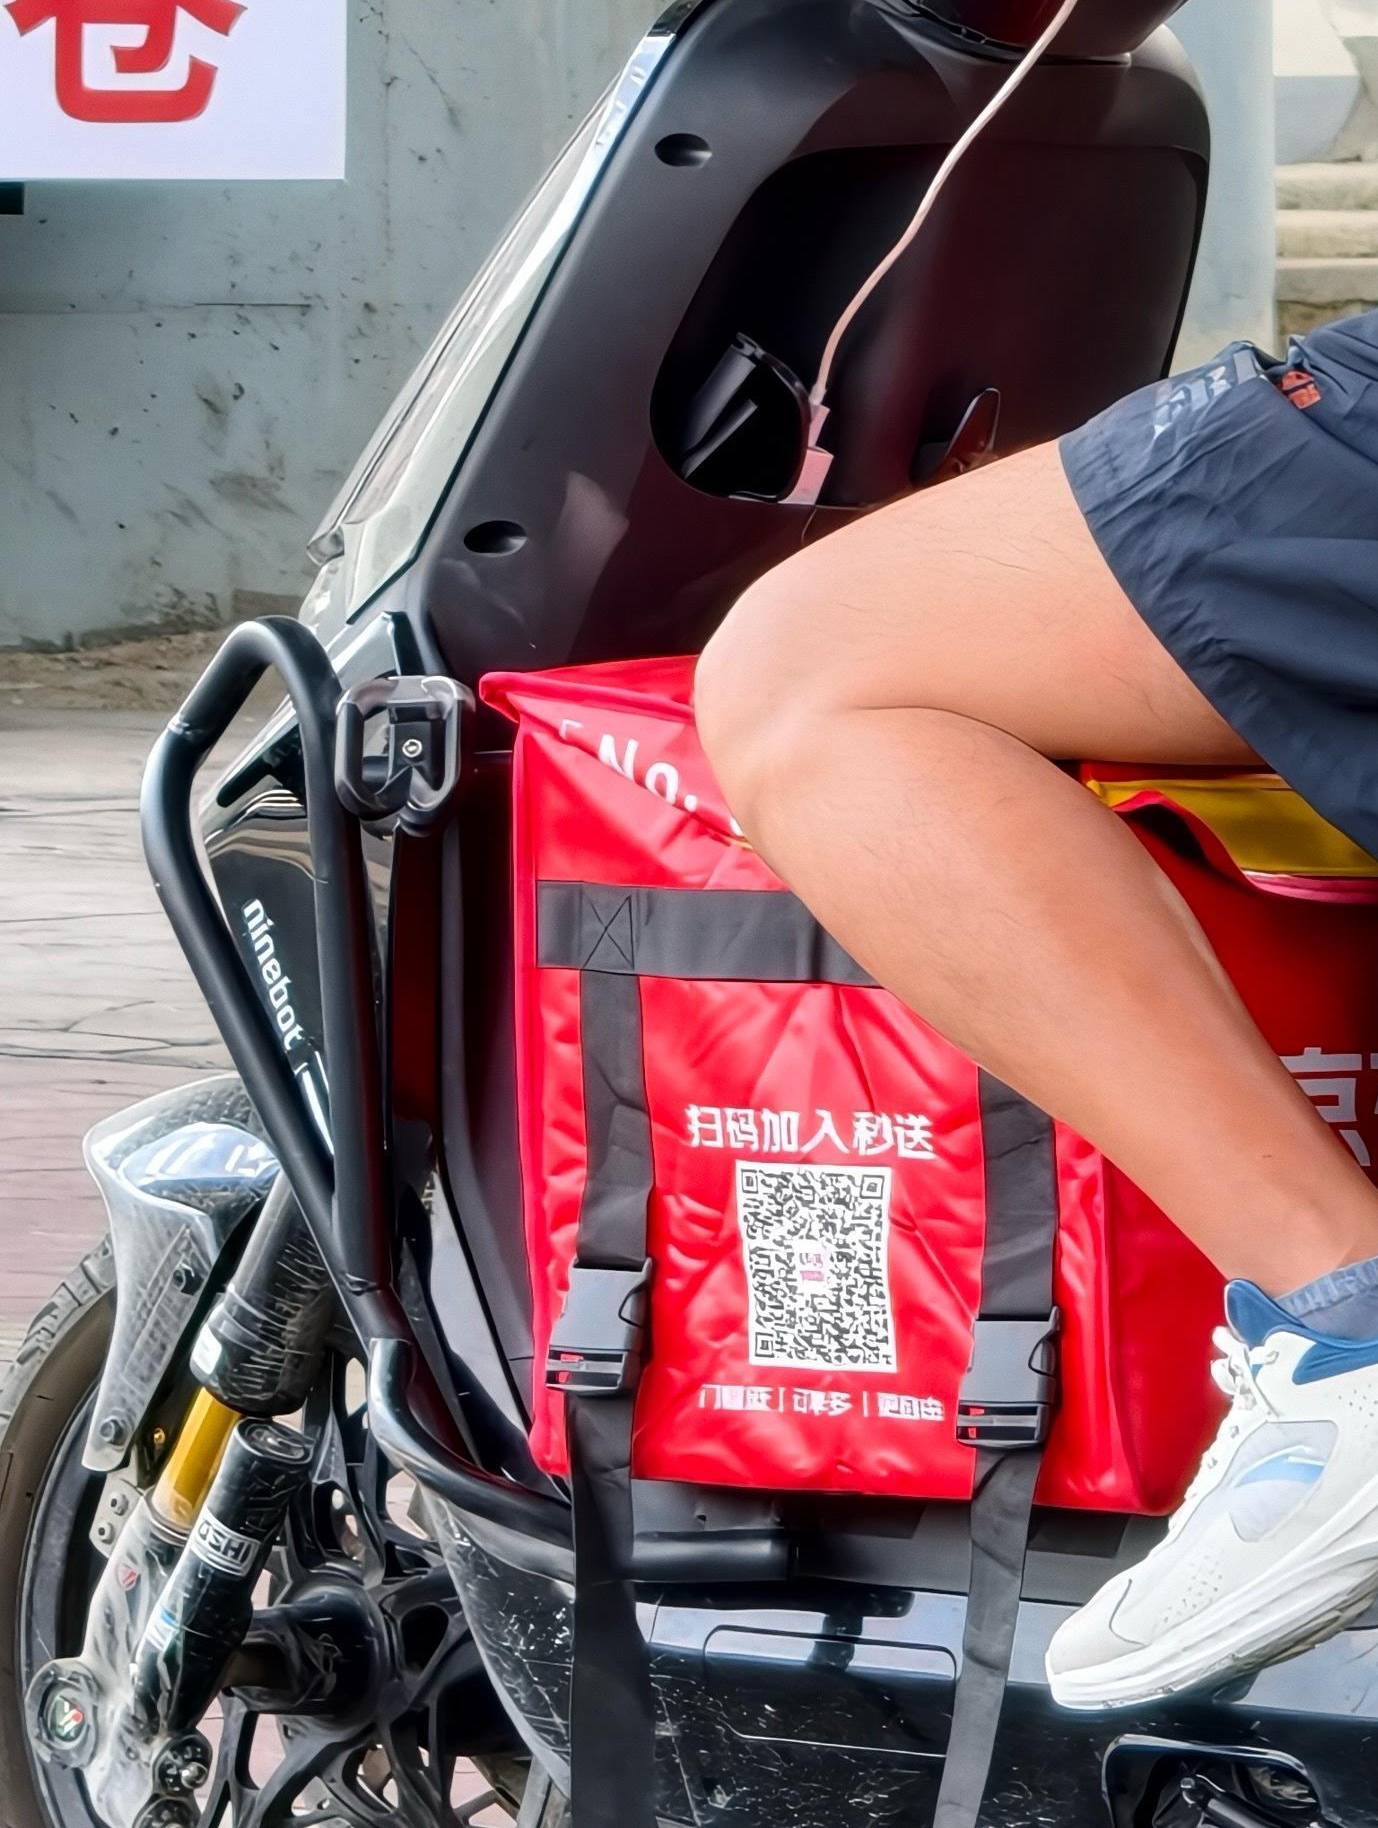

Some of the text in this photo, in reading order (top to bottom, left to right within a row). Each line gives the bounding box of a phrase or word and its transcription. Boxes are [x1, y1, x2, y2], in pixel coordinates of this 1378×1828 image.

[243, 898, 304, 1051] ninebot
[685, 1104, 937, 1160] 扫码加入秒送
